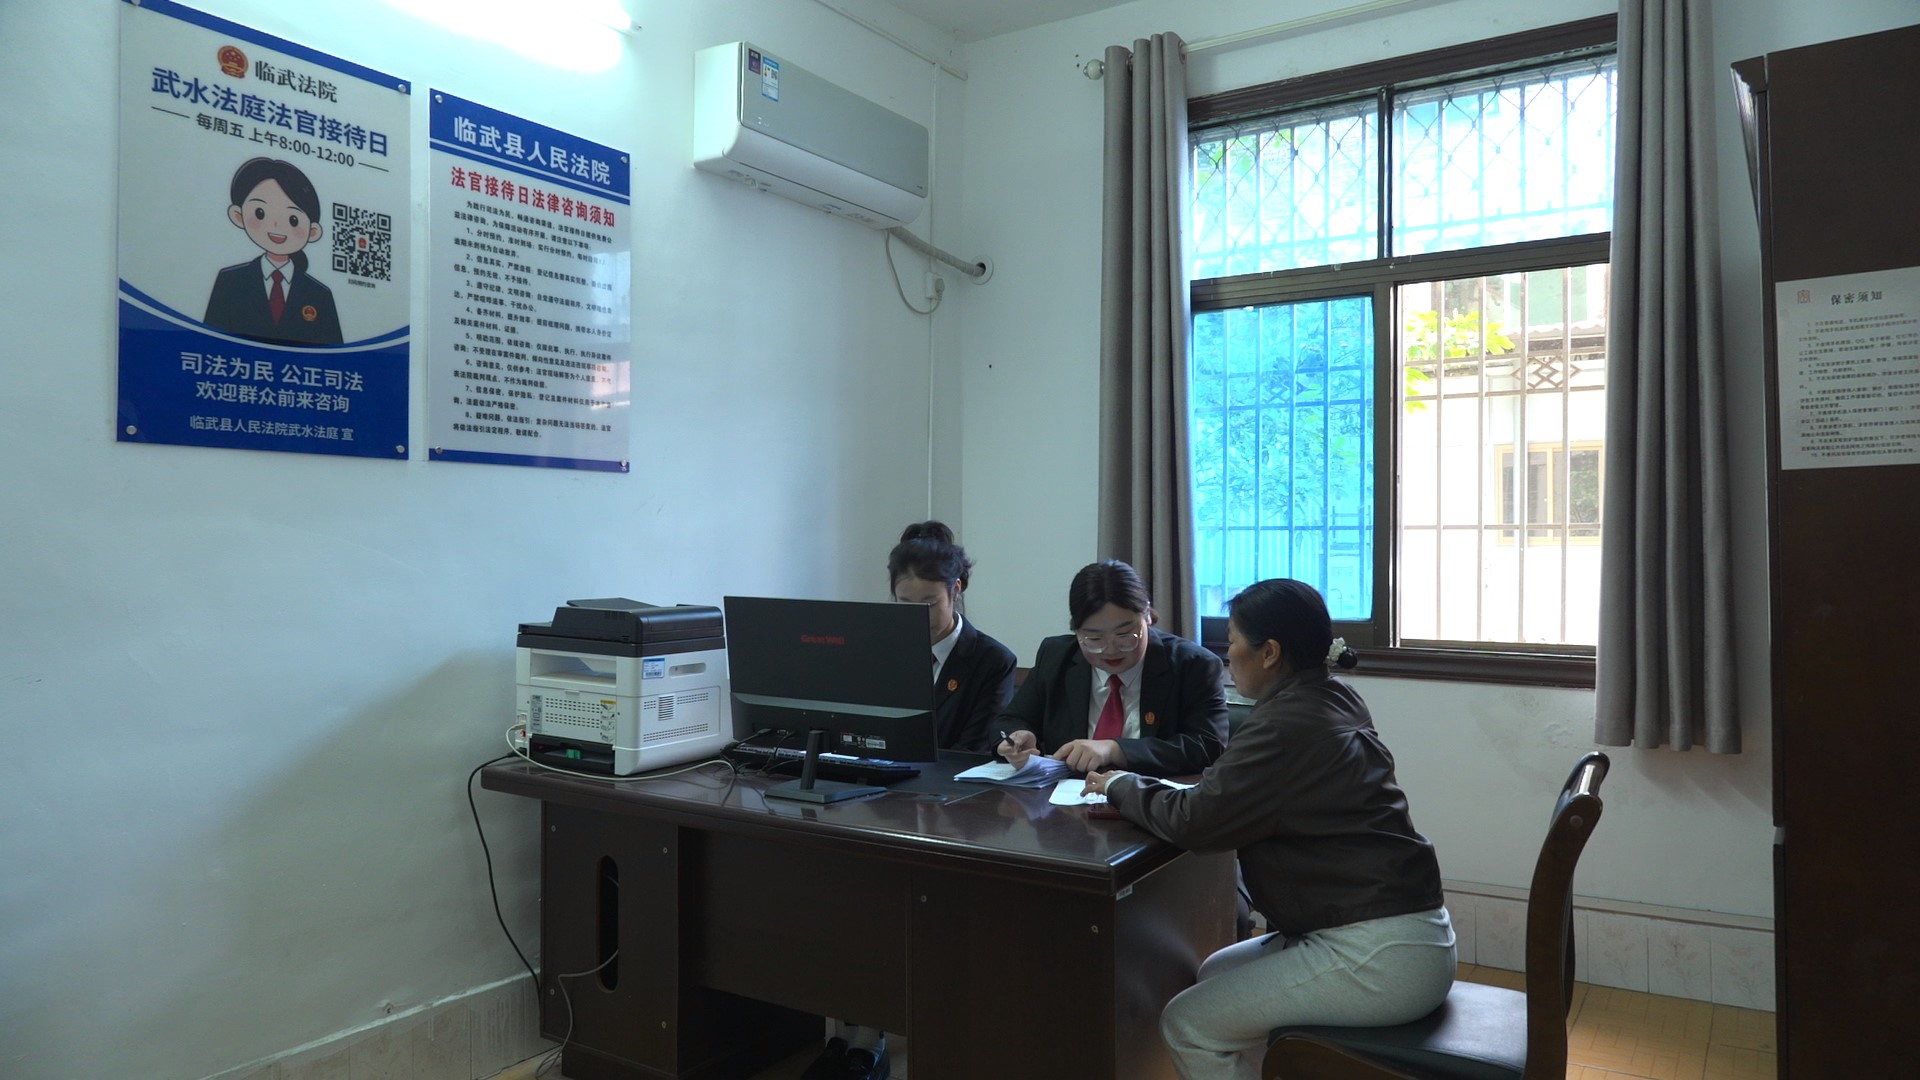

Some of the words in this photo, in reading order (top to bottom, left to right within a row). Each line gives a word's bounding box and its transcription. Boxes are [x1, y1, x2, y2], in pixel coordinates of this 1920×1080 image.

[254, 60, 338, 103] 临武法院
[151, 67, 388, 157] 武水法庭法官接待日
[454, 115, 611, 186] 临武县人民法院
[451, 166, 616, 228] 法官接待日法律咨询须知
[1831, 290, 1883, 306] 保密须知
[180, 351, 274, 382] 司法为民
[280, 363, 364, 393] 公正司法
[195, 380, 350, 413] 欢迎群众前来咨询
[189, 415, 339, 440] 临武县人民法院武水法庭
[341, 427, 354, 441] 宣
